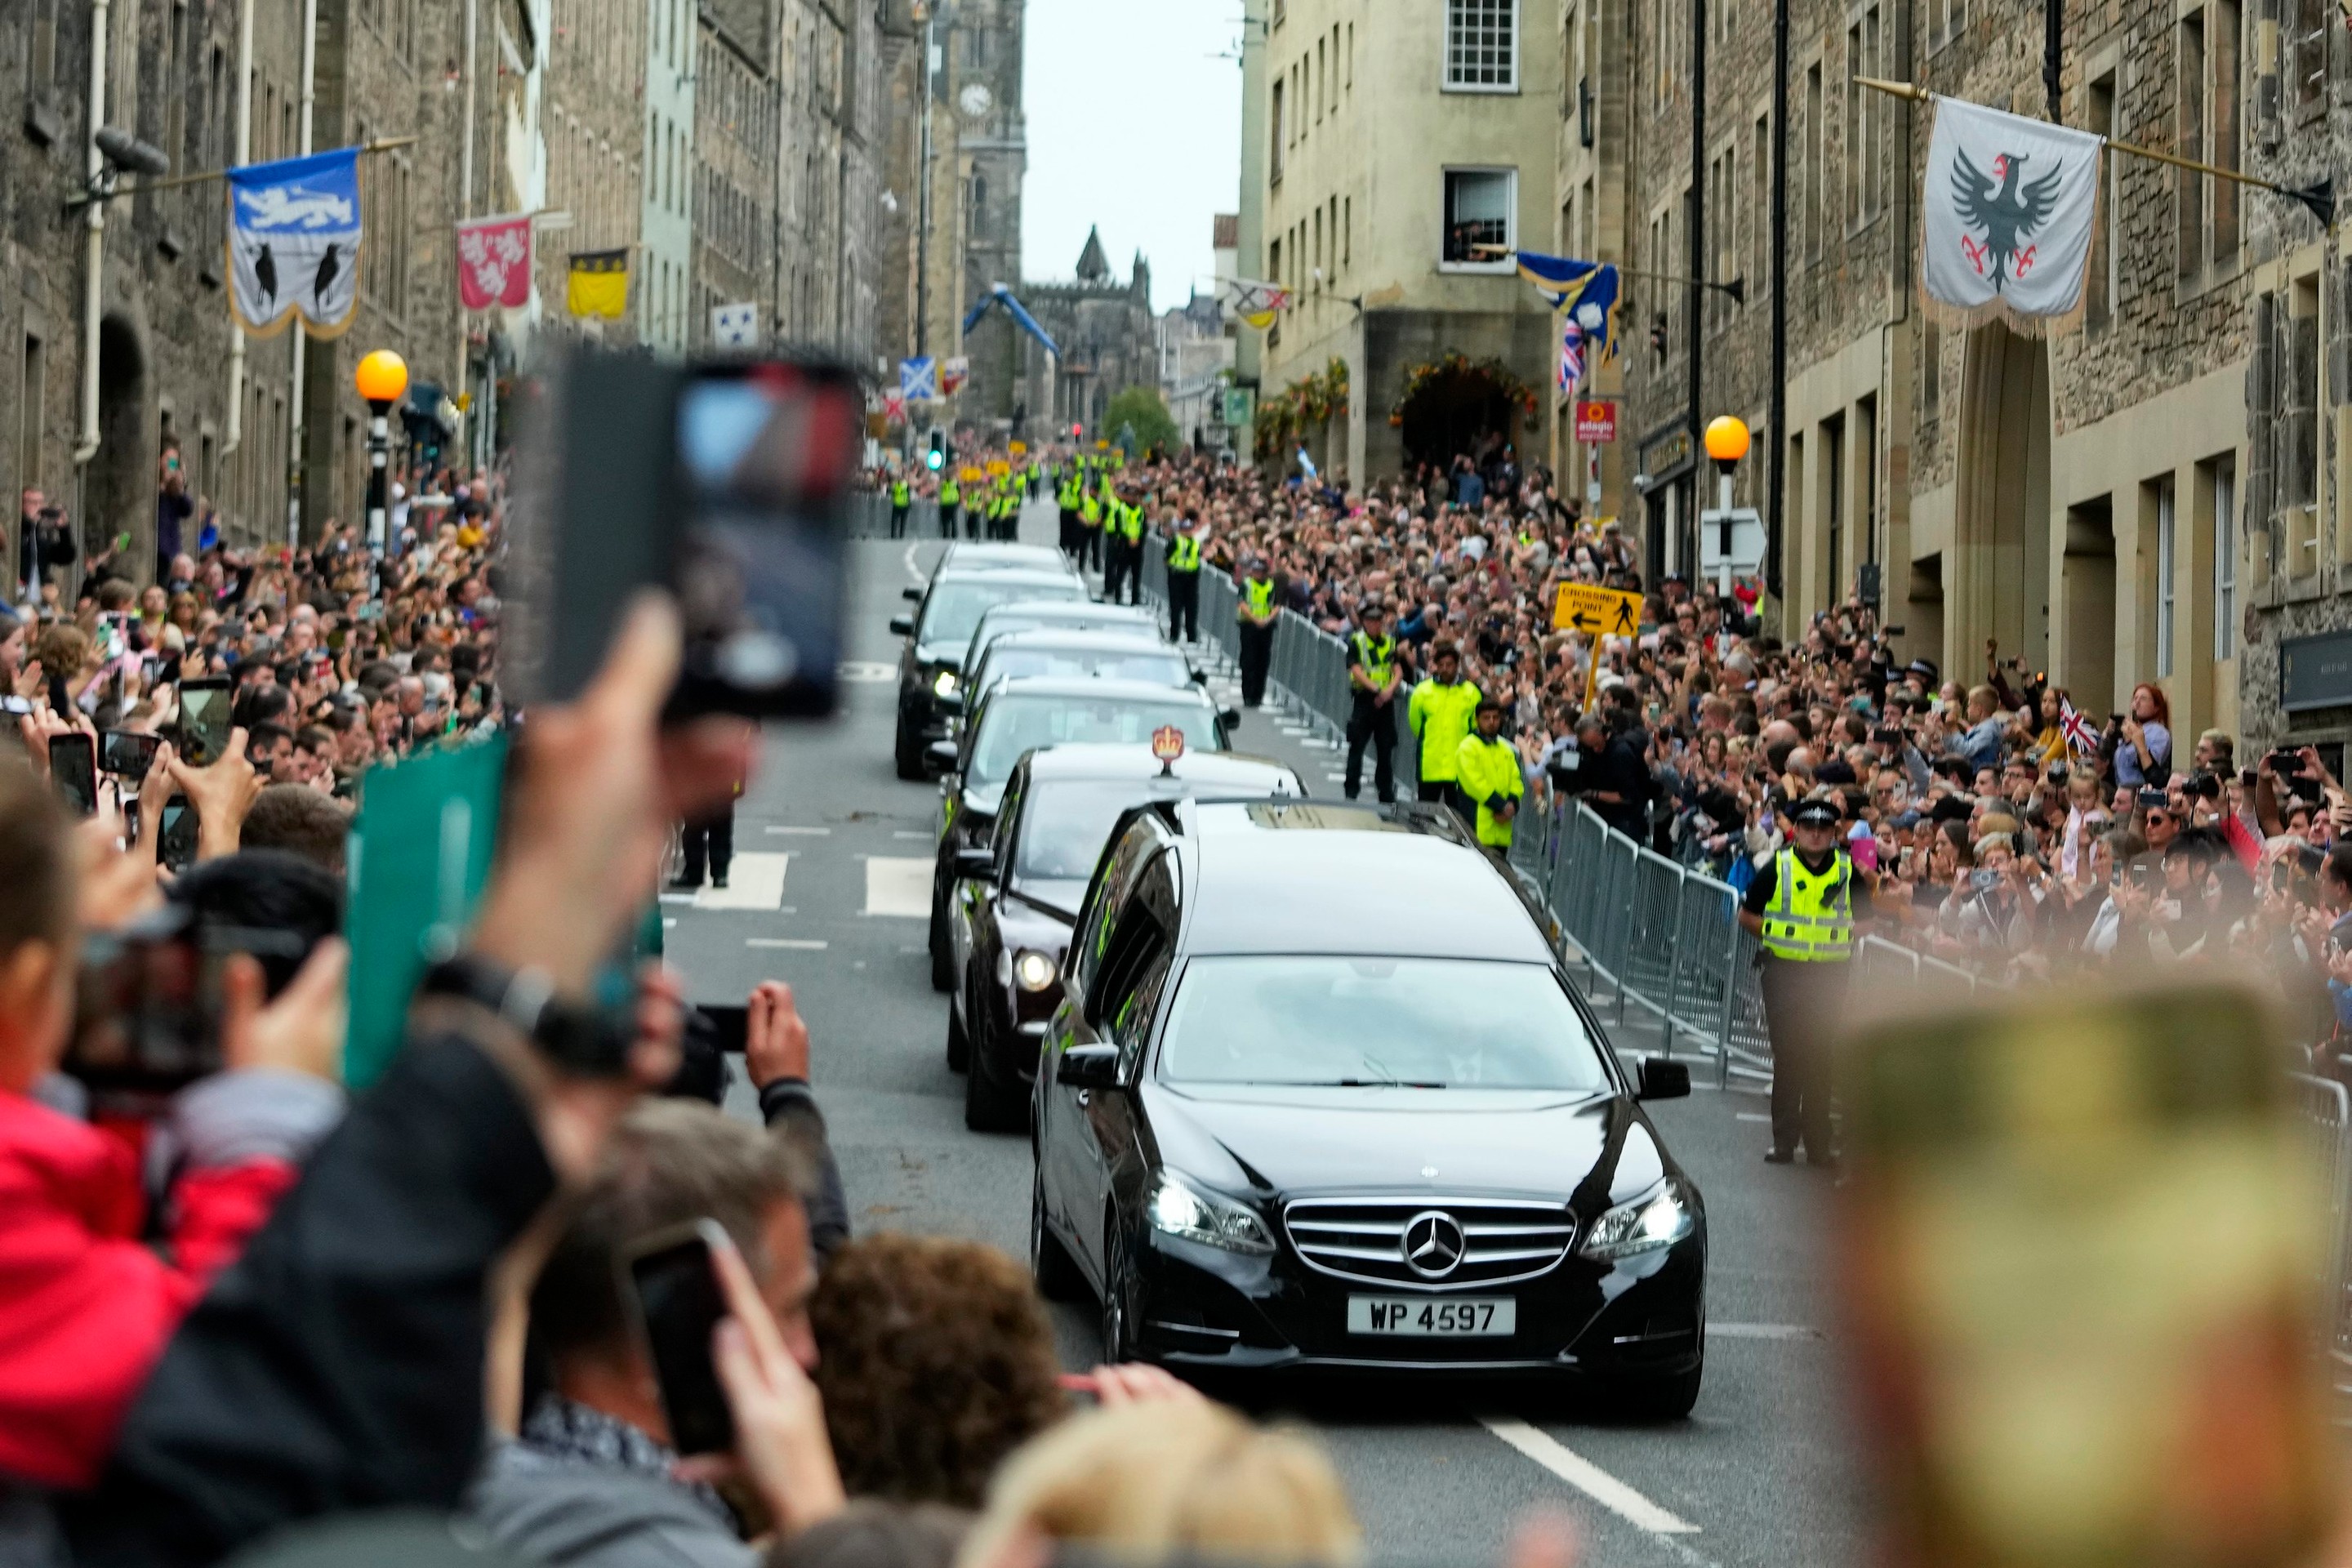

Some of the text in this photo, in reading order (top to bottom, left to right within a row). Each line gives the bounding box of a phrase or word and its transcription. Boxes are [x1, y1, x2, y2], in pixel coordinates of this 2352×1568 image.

[1562, 587, 1617, 604] CROSSING
[1572, 599, 1602, 612] POINT
[1370, 1302, 1495, 1333] WP 4597
